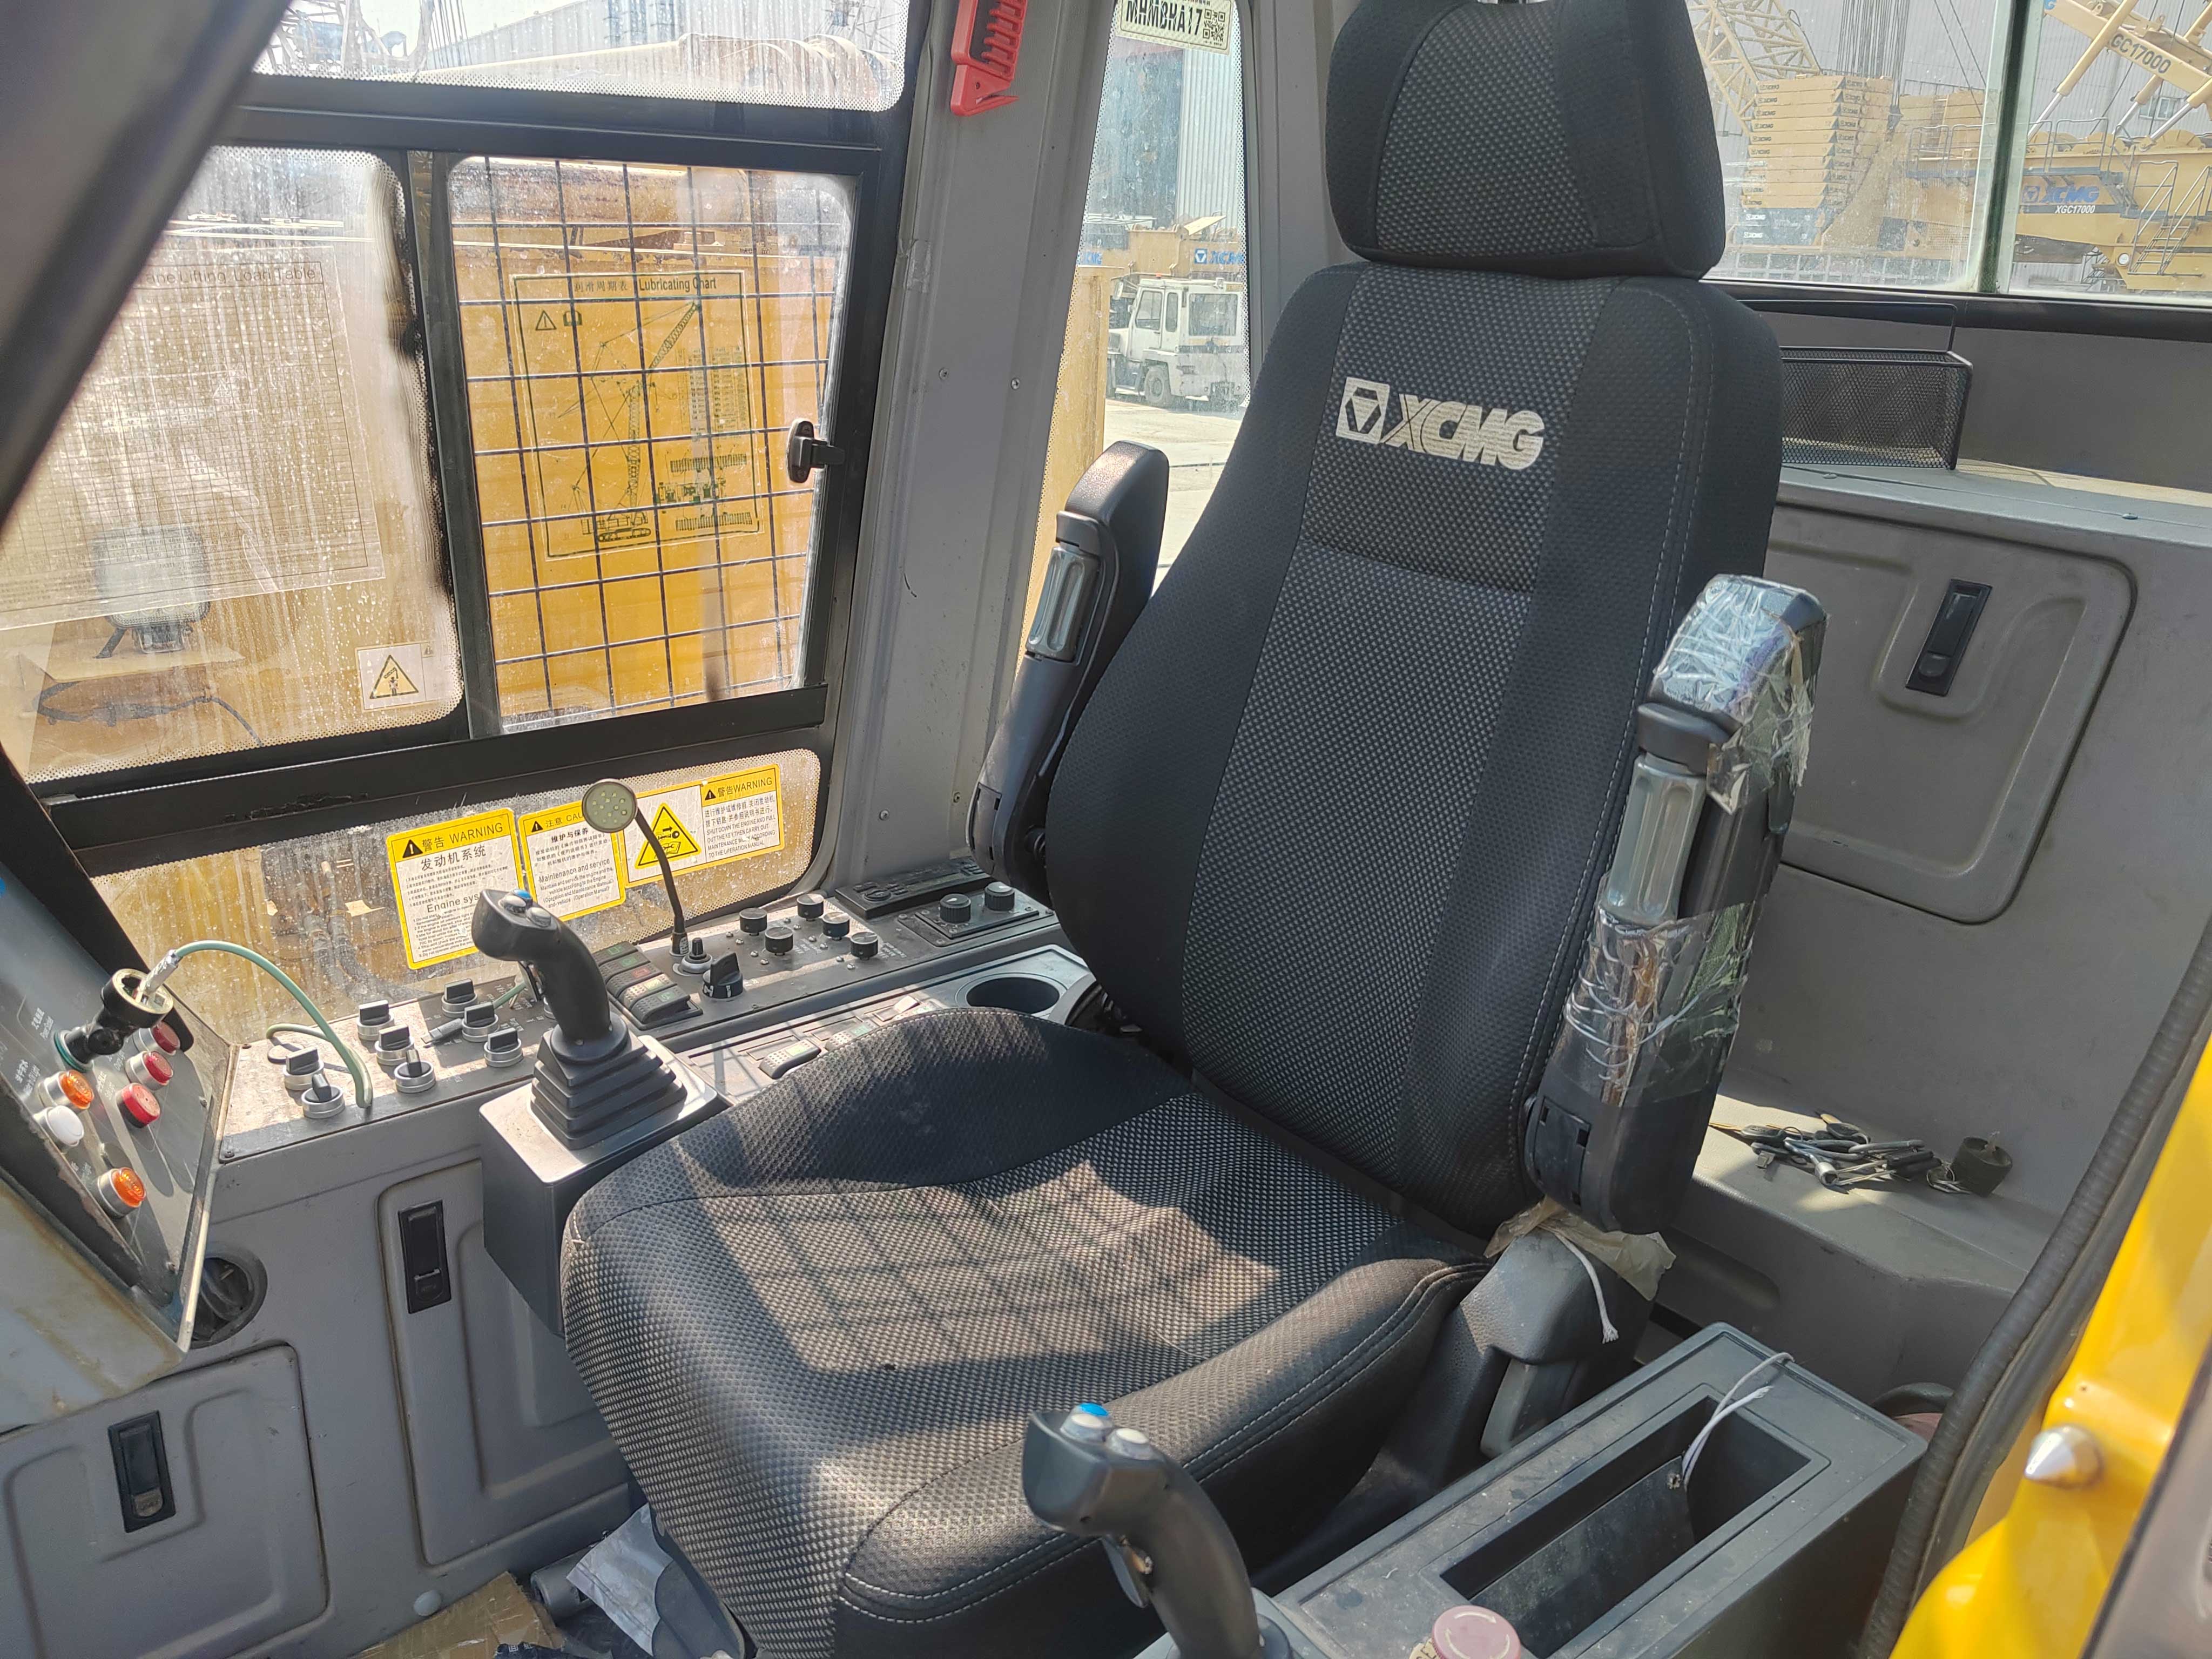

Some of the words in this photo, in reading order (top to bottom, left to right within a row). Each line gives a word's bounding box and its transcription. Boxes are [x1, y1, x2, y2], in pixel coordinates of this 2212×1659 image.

[2110, 33, 2171, 73] GC17000
[2041, 186, 2100, 203] XCMG
[2055, 205, 2096, 214] XGC17000
[1210, 250, 1244, 265] XCM
[179, 268, 226, 284] Lifting
[275, 266, 315, 279] Table
[639, 278, 690, 292] Lubricating
[1381, 394, 1545, 470] XCMG
[545, 817, 563, 828] 注意
[566, 812, 584, 822] CAU
[741, 819, 756, 827] ENGINE
[422, 835, 444, 852] 警告
[449, 822, 503, 844] WARNING
[551, 827, 589, 843] 维护与保养
[708, 838, 738, 851] MAINTENANCE
[421, 845, 487, 871] 发动机系统
[538, 868, 577, 883] Maintenance
[578, 864, 589, 872] and
[590, 858, 610, 868] service
[427, 898, 461, 913] Engine
